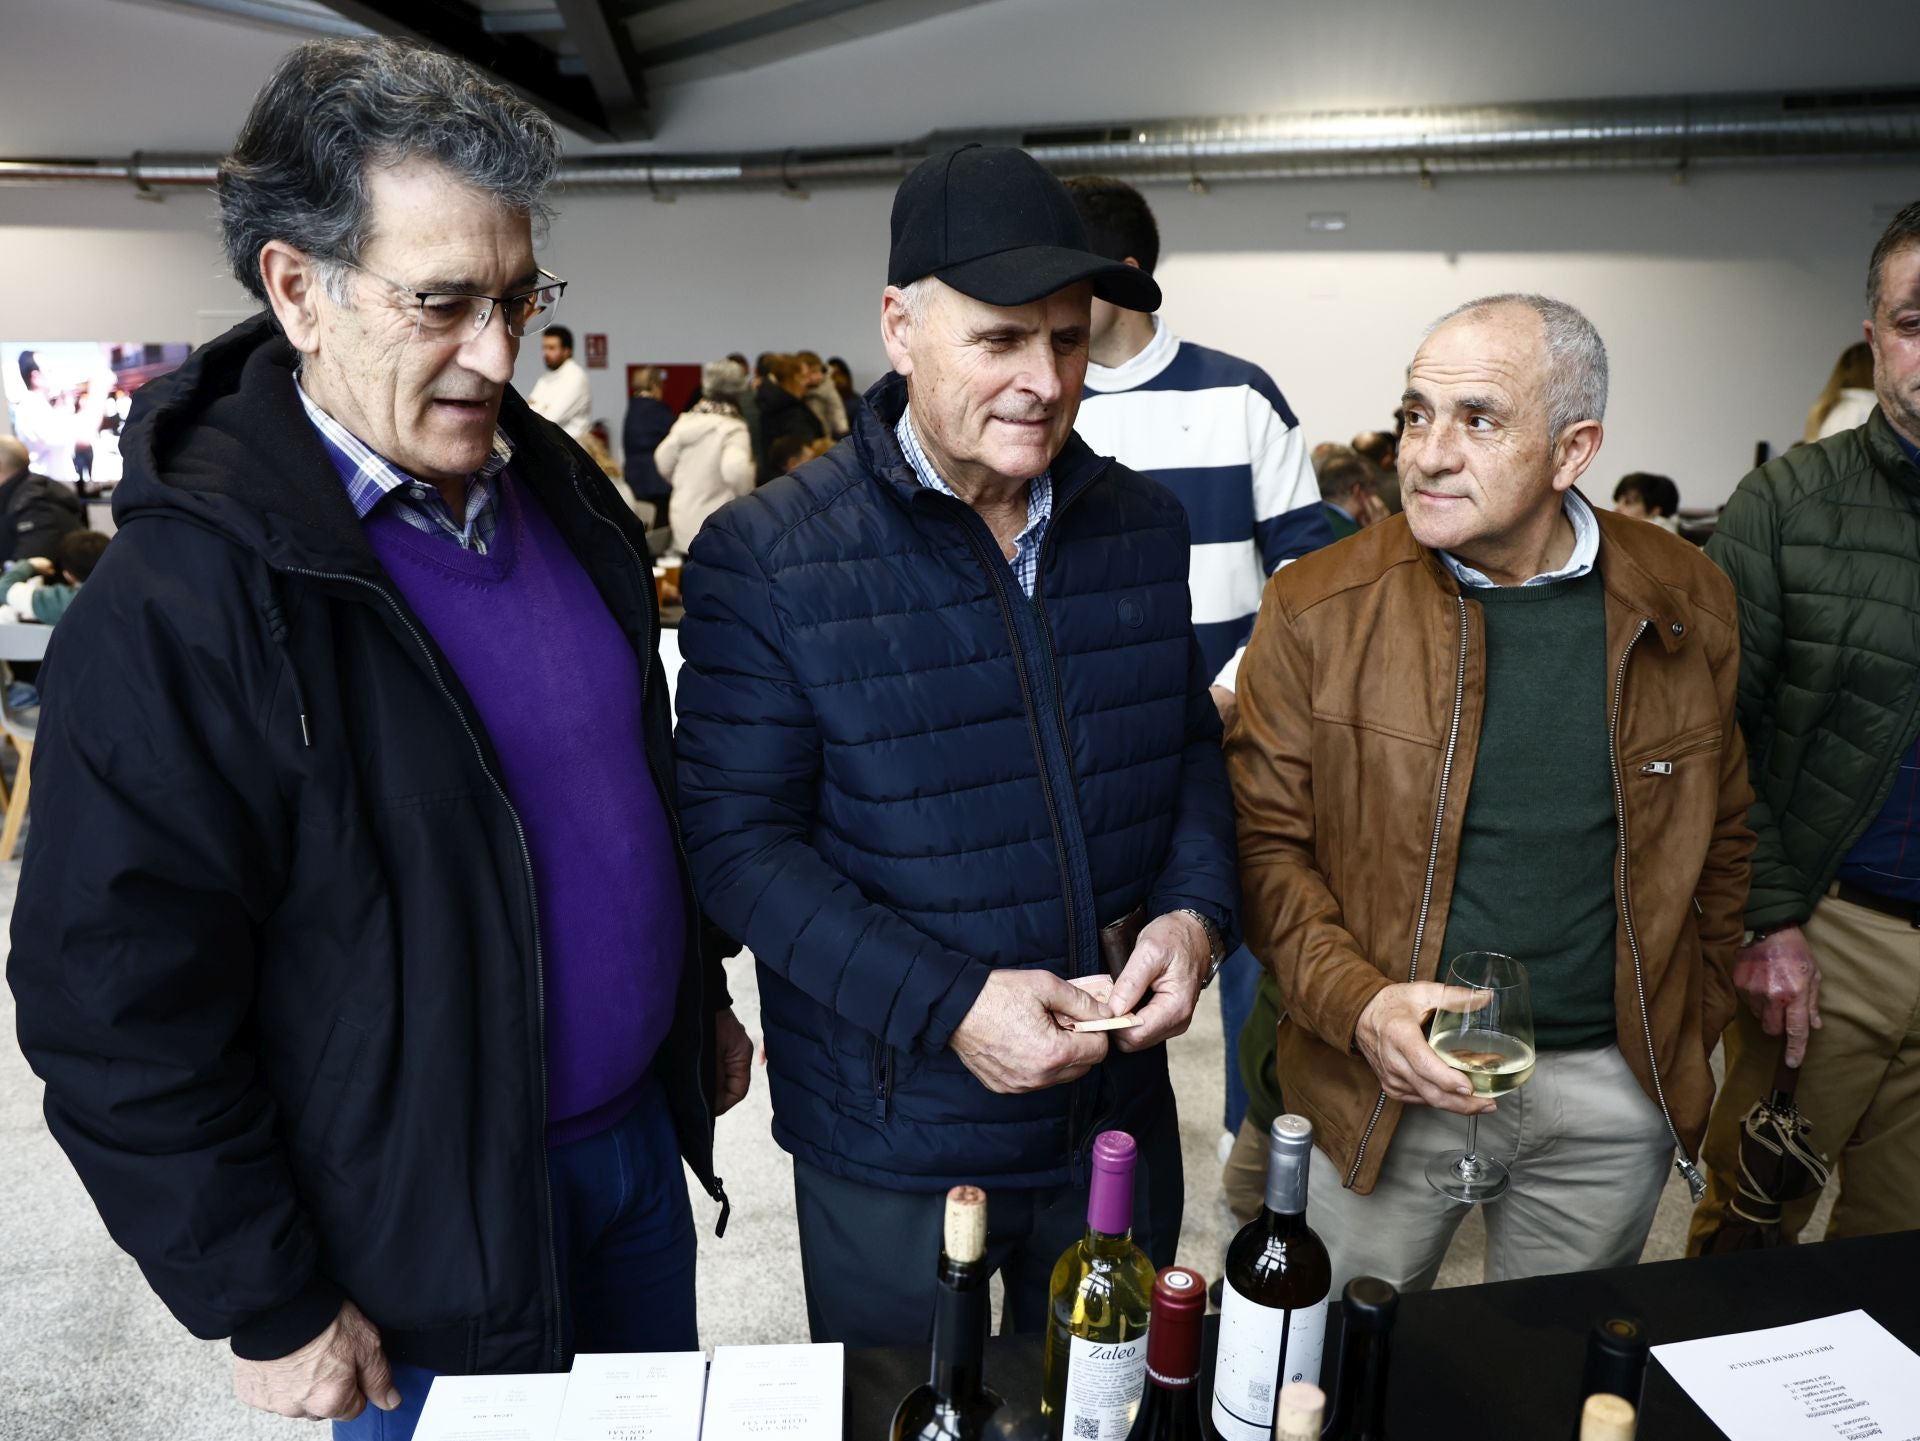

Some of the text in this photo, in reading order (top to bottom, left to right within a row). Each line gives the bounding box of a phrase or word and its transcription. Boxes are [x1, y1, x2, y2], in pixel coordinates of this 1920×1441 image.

[1088, 1345, 1136, 1360] Zaleo
[1804, 1345, 1834, 1355] PRECIO
[1783, 1351, 1804, 1360] COPA
[1739, 1358, 1771, 1368] CRISTAL
[1846, 1428, 1883, 1441] Aperitivos
